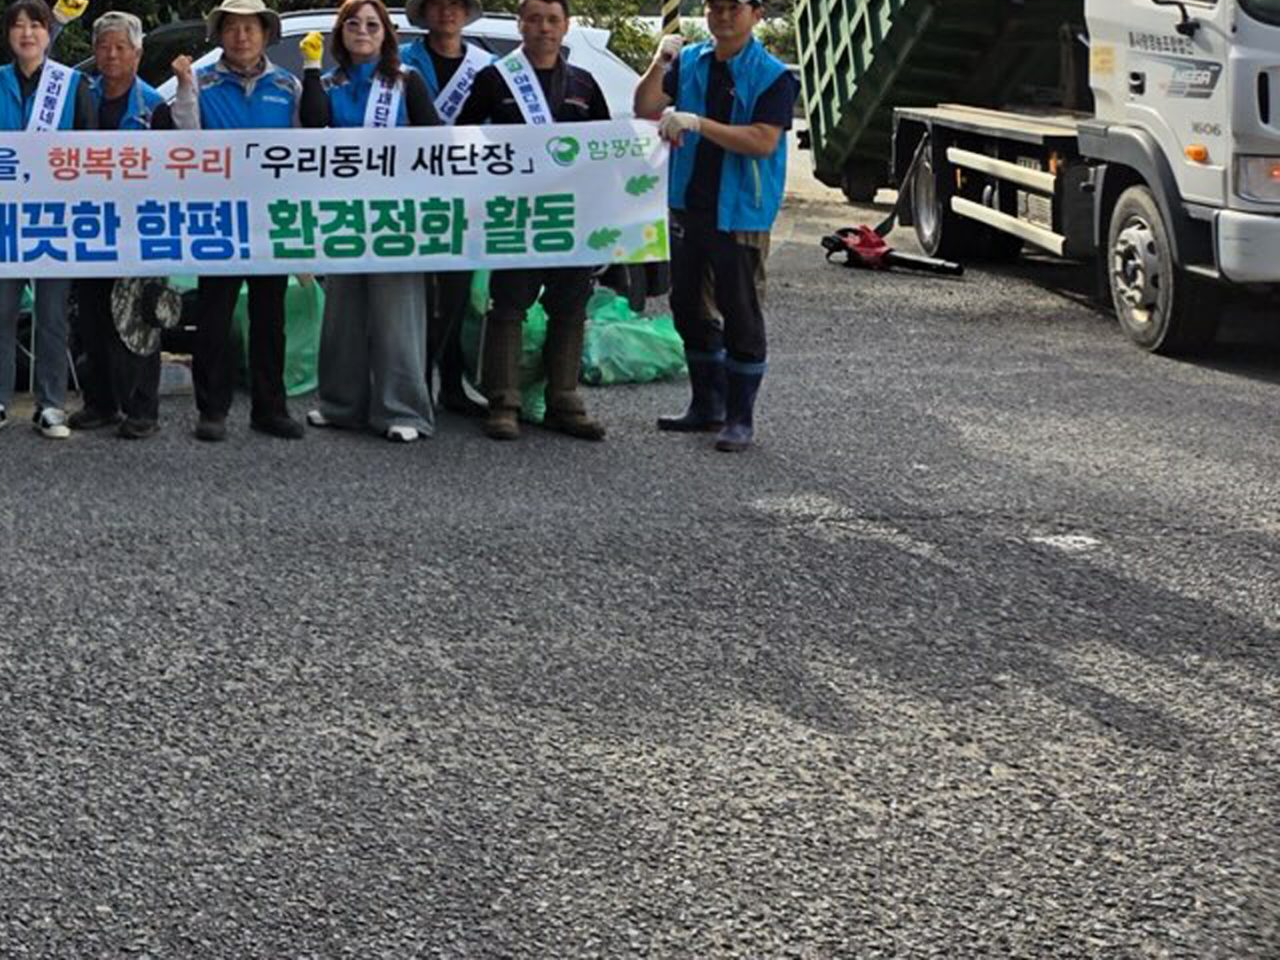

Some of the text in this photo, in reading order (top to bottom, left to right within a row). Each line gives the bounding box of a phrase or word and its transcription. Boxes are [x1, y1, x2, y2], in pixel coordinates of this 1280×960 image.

[48, 145, 152, 181] 행복한
[165, 145, 233, 180] 우리
[587, 136, 650, 160] 함평군
[136, 200, 250, 262] 함평!
[267, 198, 468, 259] 환경정화
[484, 193, 575, 254] 활동
